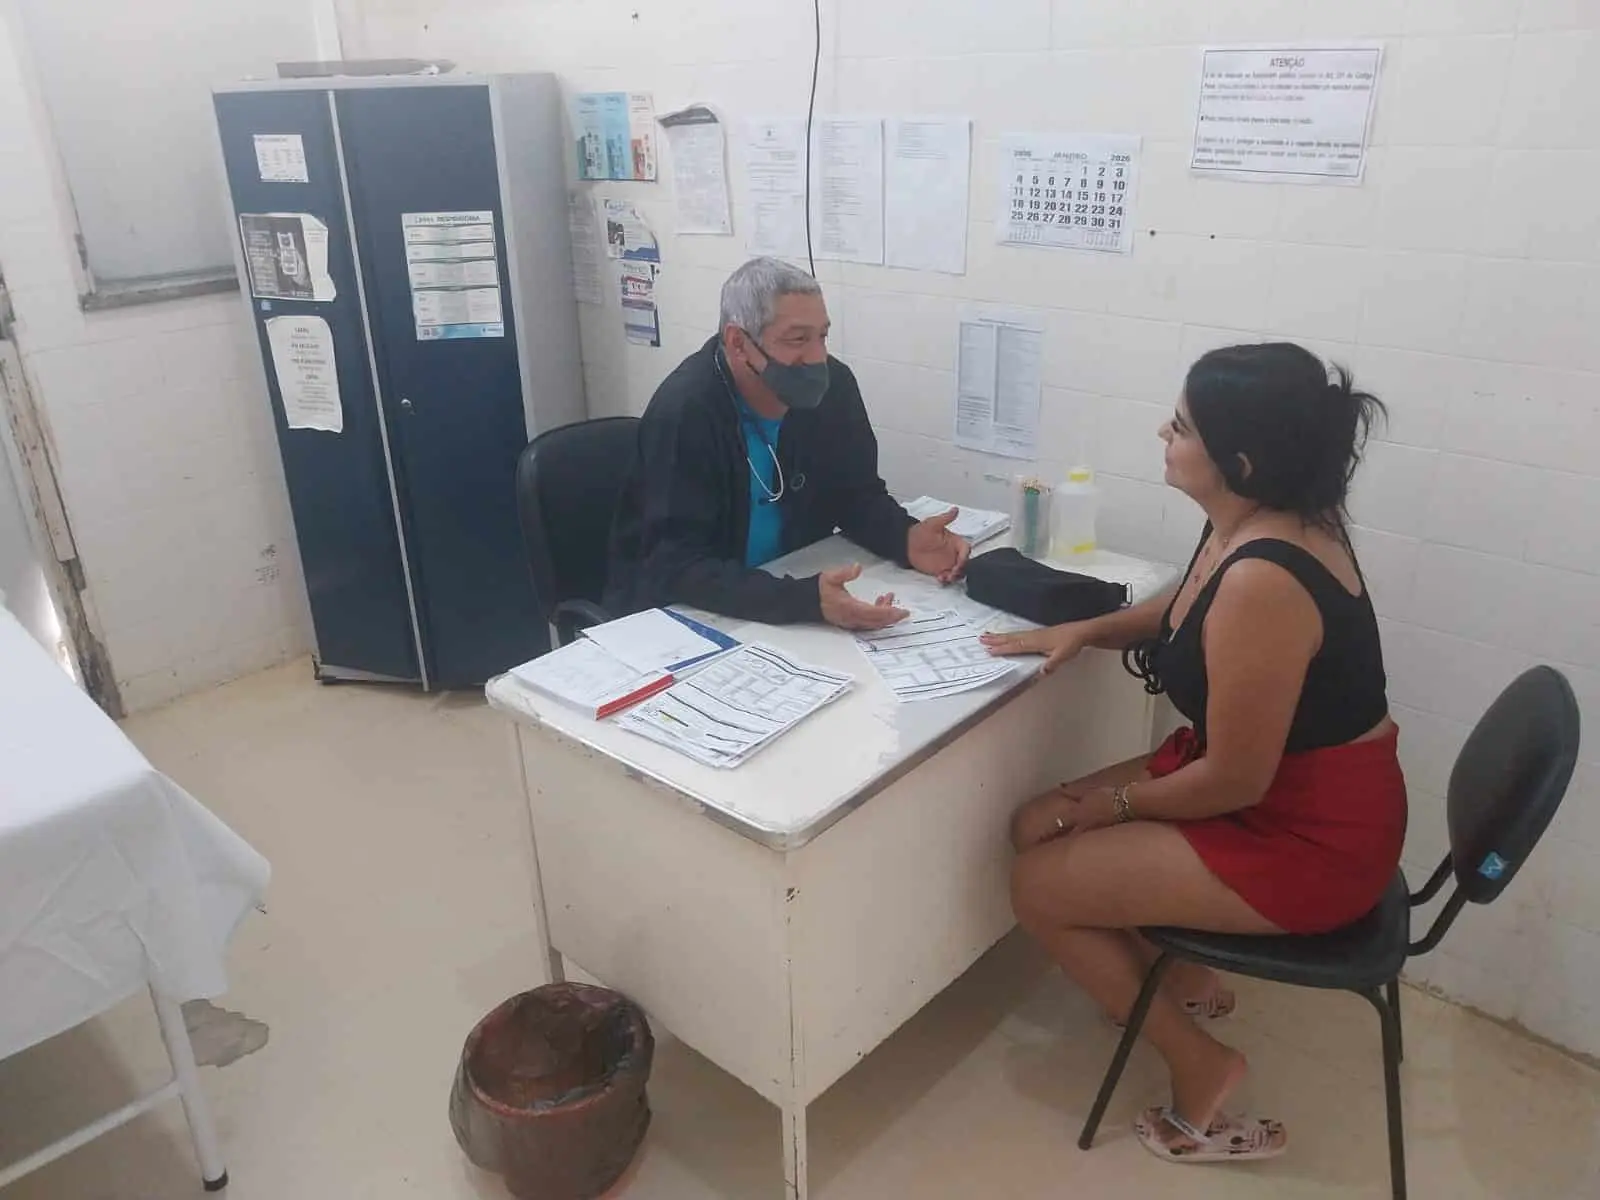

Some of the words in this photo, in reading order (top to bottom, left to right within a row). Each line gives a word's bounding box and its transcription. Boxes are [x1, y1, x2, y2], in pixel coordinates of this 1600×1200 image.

[1270, 56, 1305, 69] ATENÇÃO
[1110, 154, 1130, 162] 2026
[1082, 166, 1088, 175] 1
[1098, 167, 1105, 177] 2
[1115, 168, 1123, 178] 3
[1016, 174, 1023, 184] 4
[1032, 175, 1039, 185] 5
[1048, 176, 1055, 186] 6
[1064, 177, 1071, 187] 7
[1080, 178, 1087, 188] 8
[1097, 179, 1104, 189] 9
[1113, 180, 1125, 190] 10
[1014, 187, 1024, 196] 11
[1030, 188, 1040, 197] 12
[1045, 189, 1056, 198] 13
[1061, 190, 1072, 200] 14
[1078, 191, 1089, 201] 15
[1094, 192, 1106, 202] 16
[1111, 193, 1123, 203] 17
[1013, 199, 1024, 209] 18
[1030, 200, 1040, 210] 19
[1044, 201, 1057, 211] 20
[1060, 202, 1071, 212] 21
[1075, 203, 1088, 213] 22
[1091, 204, 1105, 214] 23
[1109, 206, 1122, 216] 24
[1011, 211, 1023, 220] 25
[1027, 212, 1039, 221] 26
[1043, 213, 1055, 222] 27
[1058, 214, 1071, 224] 28
[1074, 216, 1087, 225] 29
[1091, 217, 1104, 227] 30
[1108, 219, 1121, 228] 31
